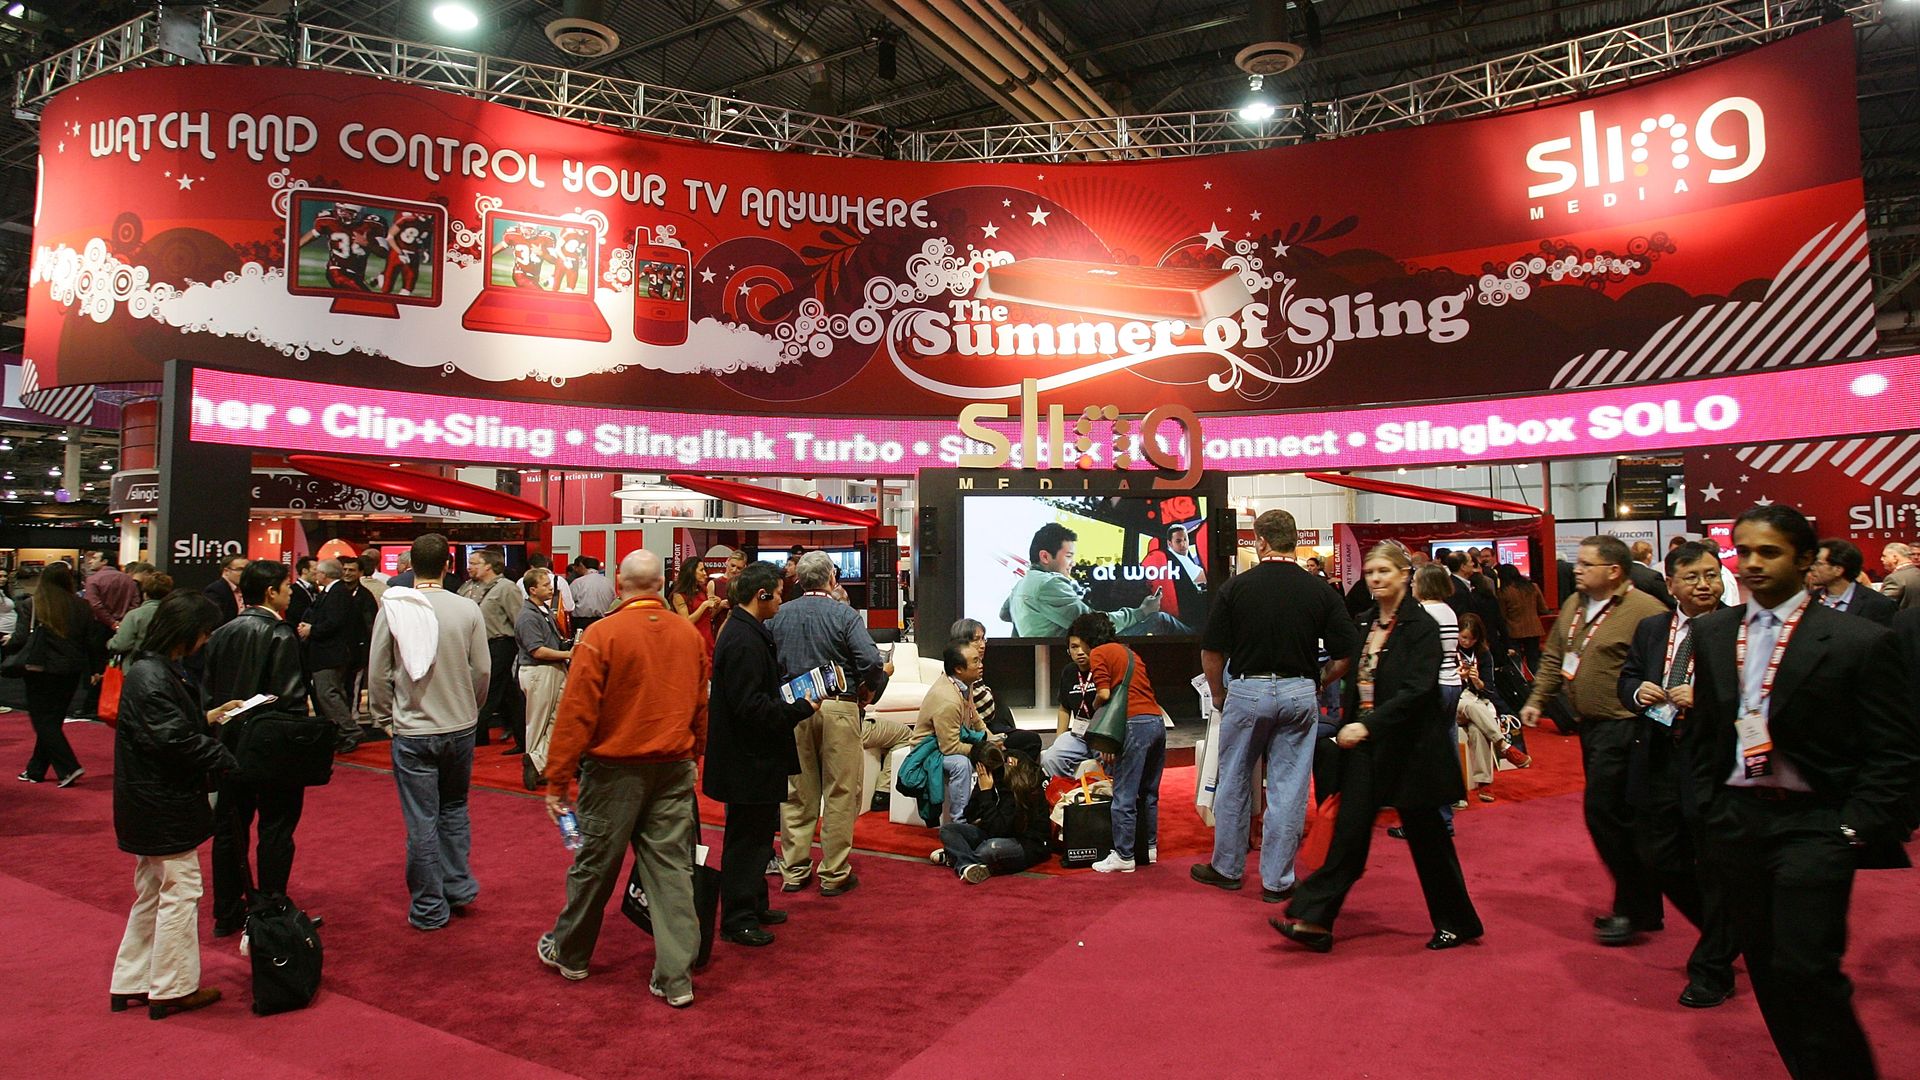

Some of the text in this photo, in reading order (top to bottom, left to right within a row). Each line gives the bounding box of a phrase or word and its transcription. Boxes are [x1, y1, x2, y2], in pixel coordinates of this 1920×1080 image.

[90, 112, 937, 234] WATCH AND CONTROL YOUR TV ANYWHERE.
[1526, 97, 1766, 198] sling
[1530, 179, 1689, 220] MEDIA
[912, 291, 1470, 356] Summer of Sling
[949, 300, 1009, 322] The
[192, 386, 275, 431] her
[322, 403, 555, 457] Clip+Sling
[594, 424, 776, 464] Slinglink
[786, 432, 903, 463] Turbo
[1375, 416, 1576, 455] Slingbox
[1588, 394, 1740, 439] SOLO
[958, 378, 1204, 490] sling
[958, 477, 1130, 490] MEDIA
[1093, 560, 1180, 581] at work
